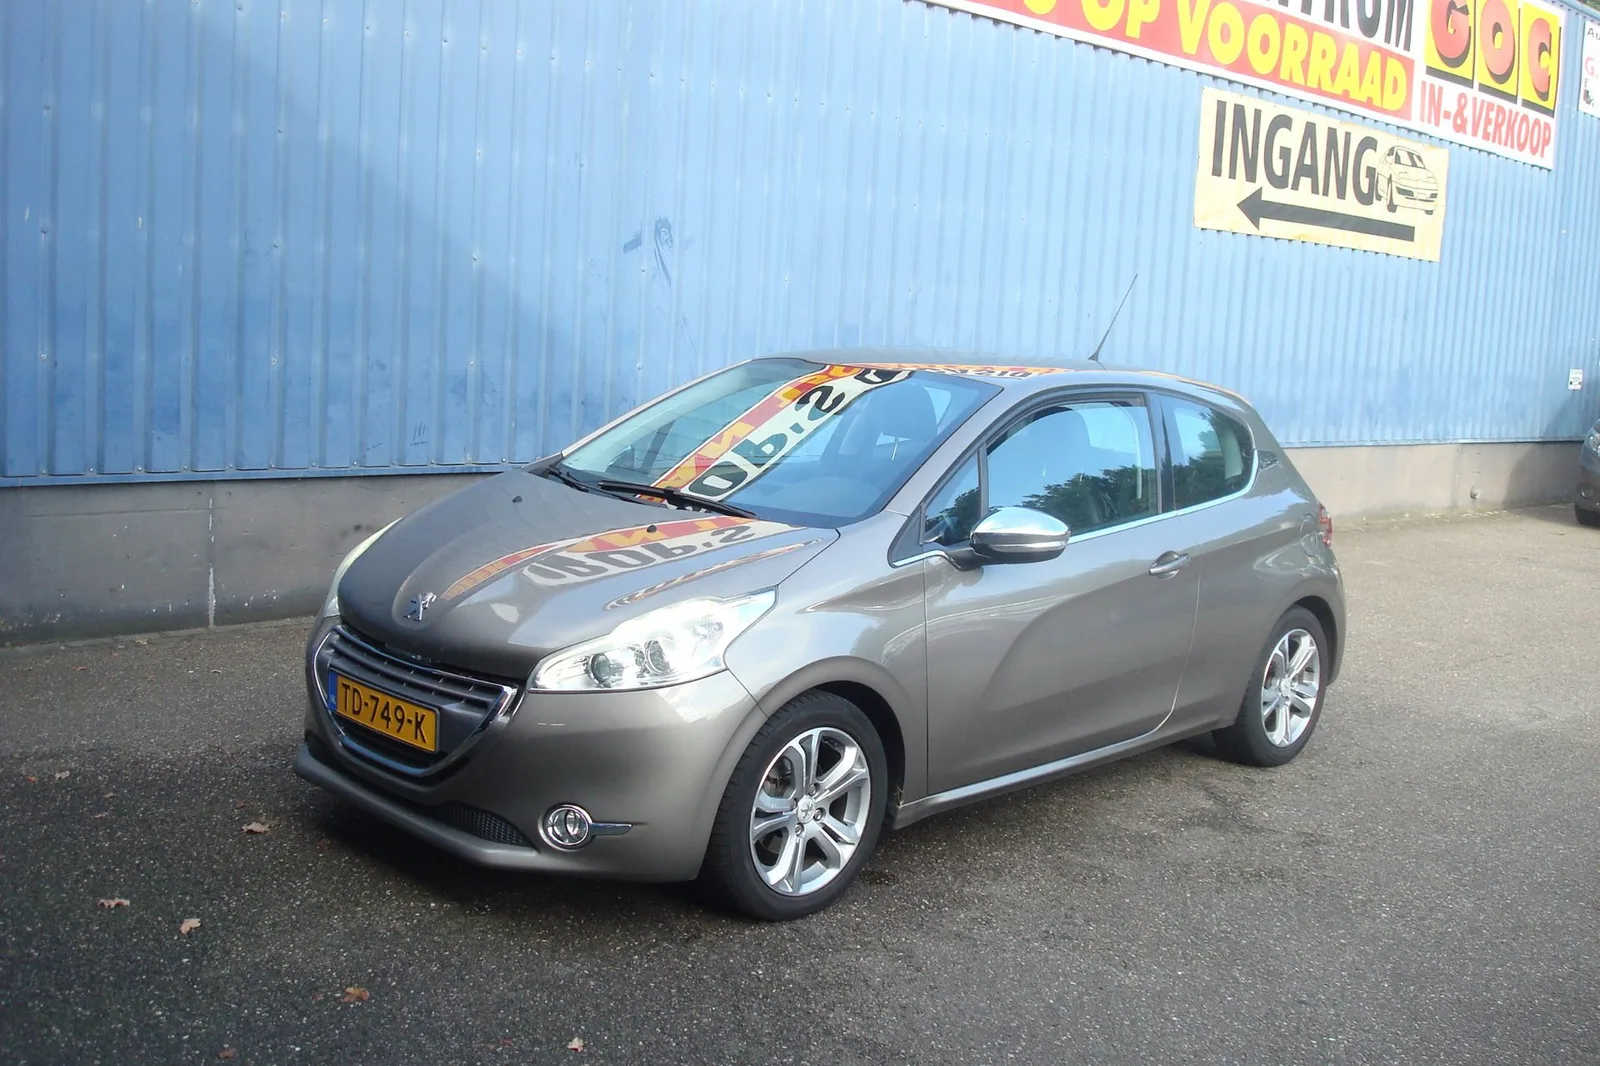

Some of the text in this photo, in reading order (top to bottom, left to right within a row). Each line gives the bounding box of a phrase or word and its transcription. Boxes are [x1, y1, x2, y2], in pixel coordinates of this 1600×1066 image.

[1177, 0, 1408, 111] VOORRAAD
[1431, 0, 1552, 101] GOC
[1211, 100, 1378, 206] INGANG
[341, 682, 427, 744] TD-749-K
